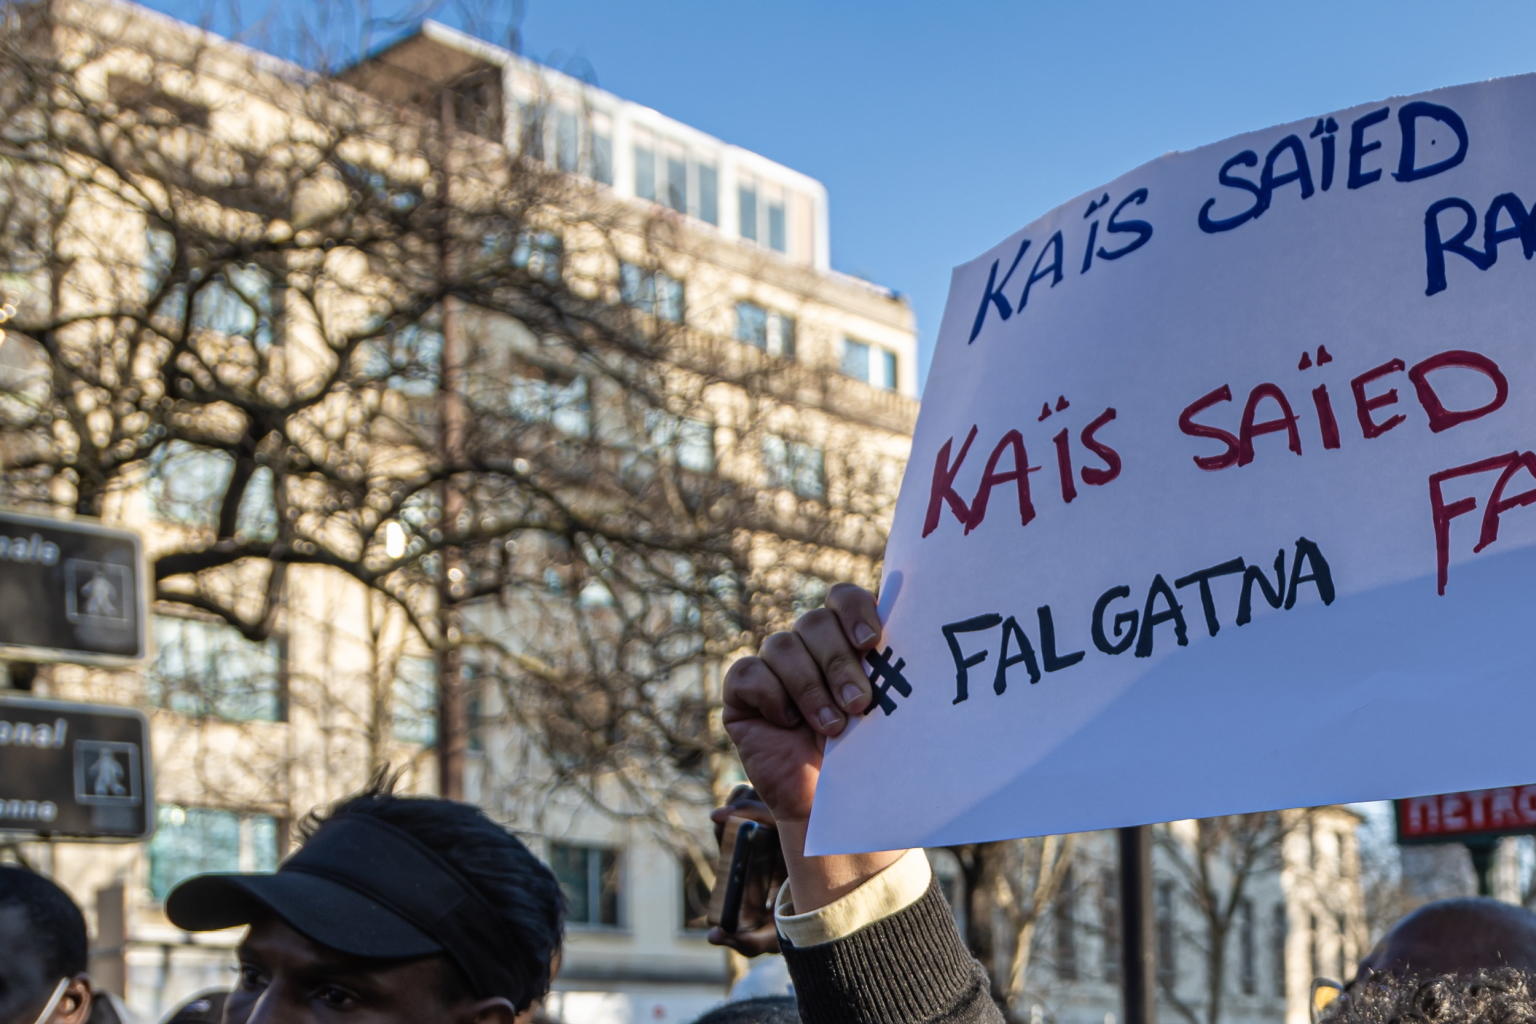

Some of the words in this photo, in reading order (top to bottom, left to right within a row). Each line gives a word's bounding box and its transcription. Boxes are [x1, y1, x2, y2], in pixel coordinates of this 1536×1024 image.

[968, 186, 1154, 345] KAÏS
[1199, 100, 1469, 234] SAÏED
[922, 396, 1121, 538] KAÏS
[1178, 345, 1509, 472] SAÏED
[942, 536, 1337, 705] FALGATNA
